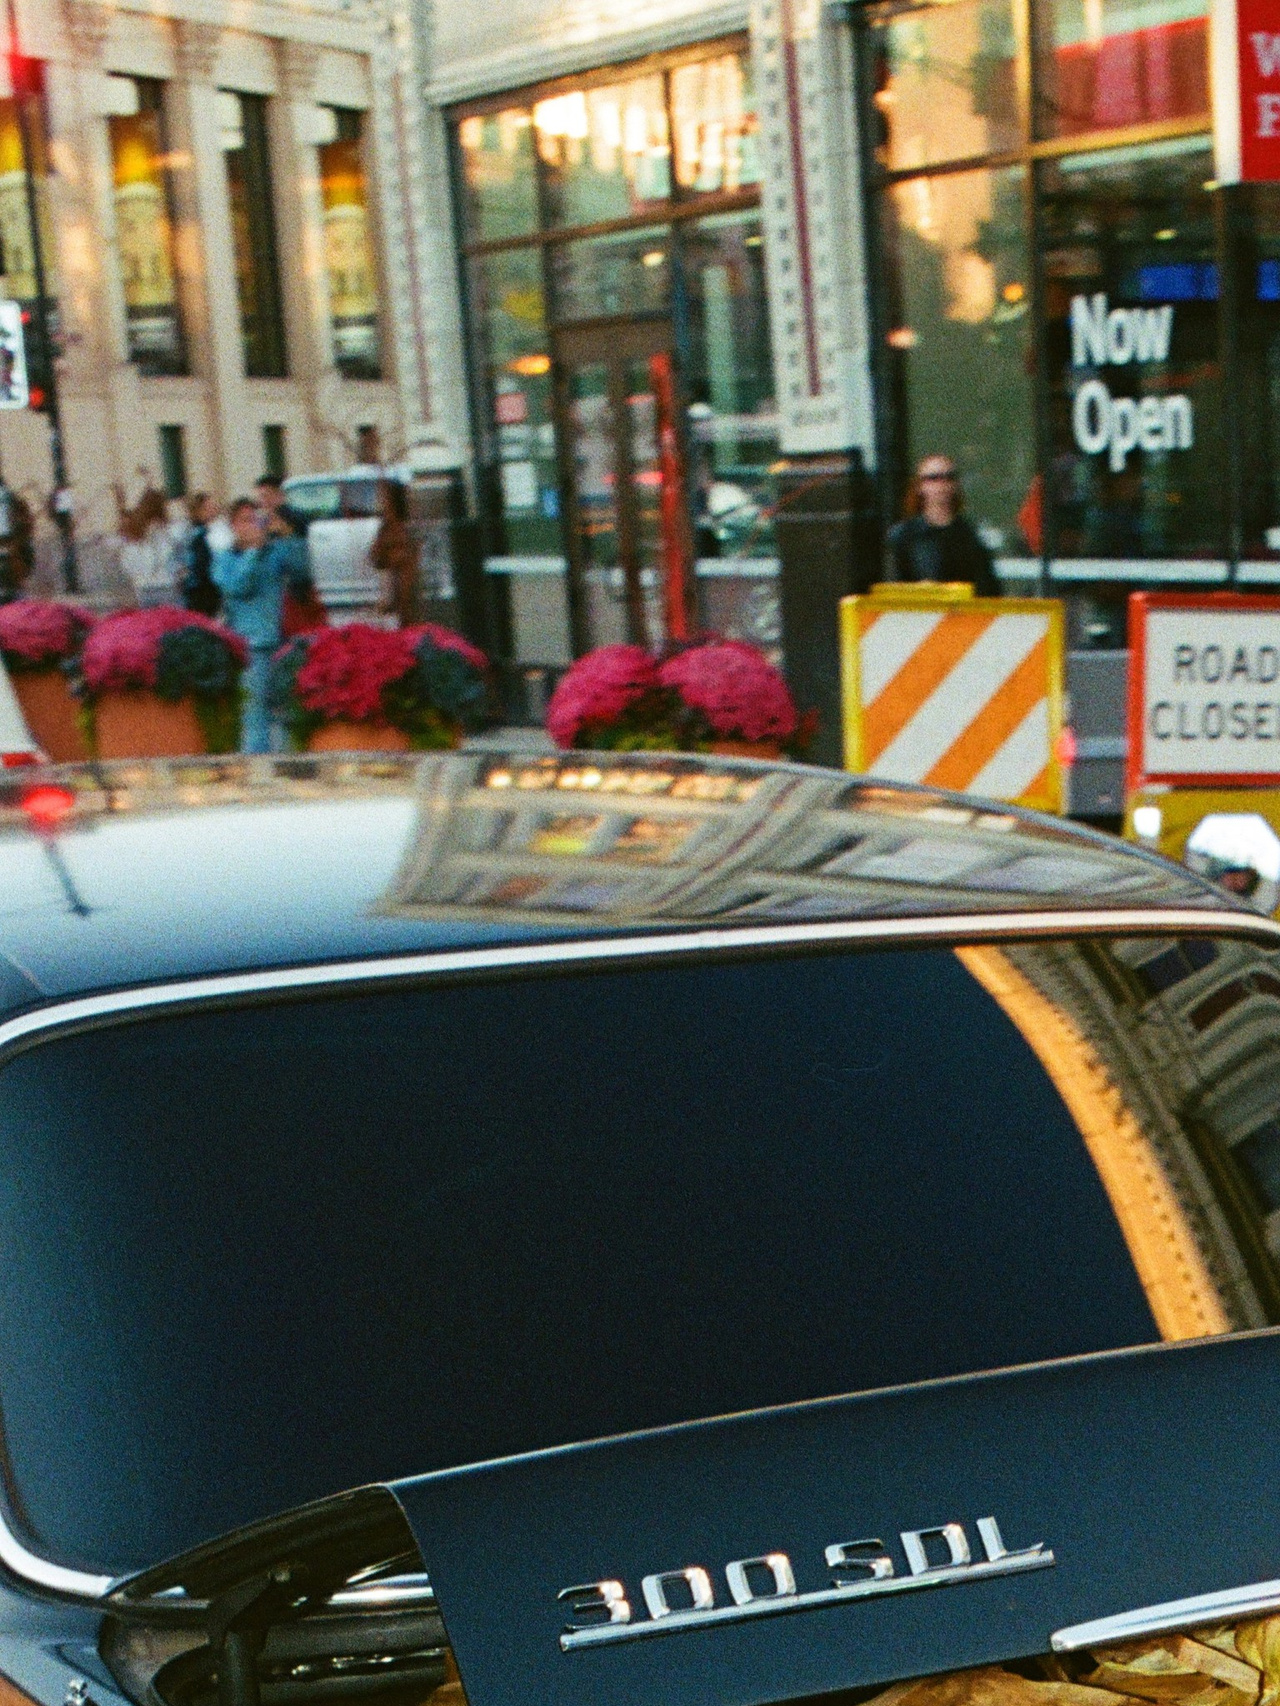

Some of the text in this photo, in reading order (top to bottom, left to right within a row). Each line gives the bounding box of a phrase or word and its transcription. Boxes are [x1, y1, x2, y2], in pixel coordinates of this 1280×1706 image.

[1071, 291, 1175, 367] Now
[1073, 380, 1193, 474] Open
[1174, 643, 1280, 684] ROAD
[557, 1516, 1045, 1630] 300 SDL
